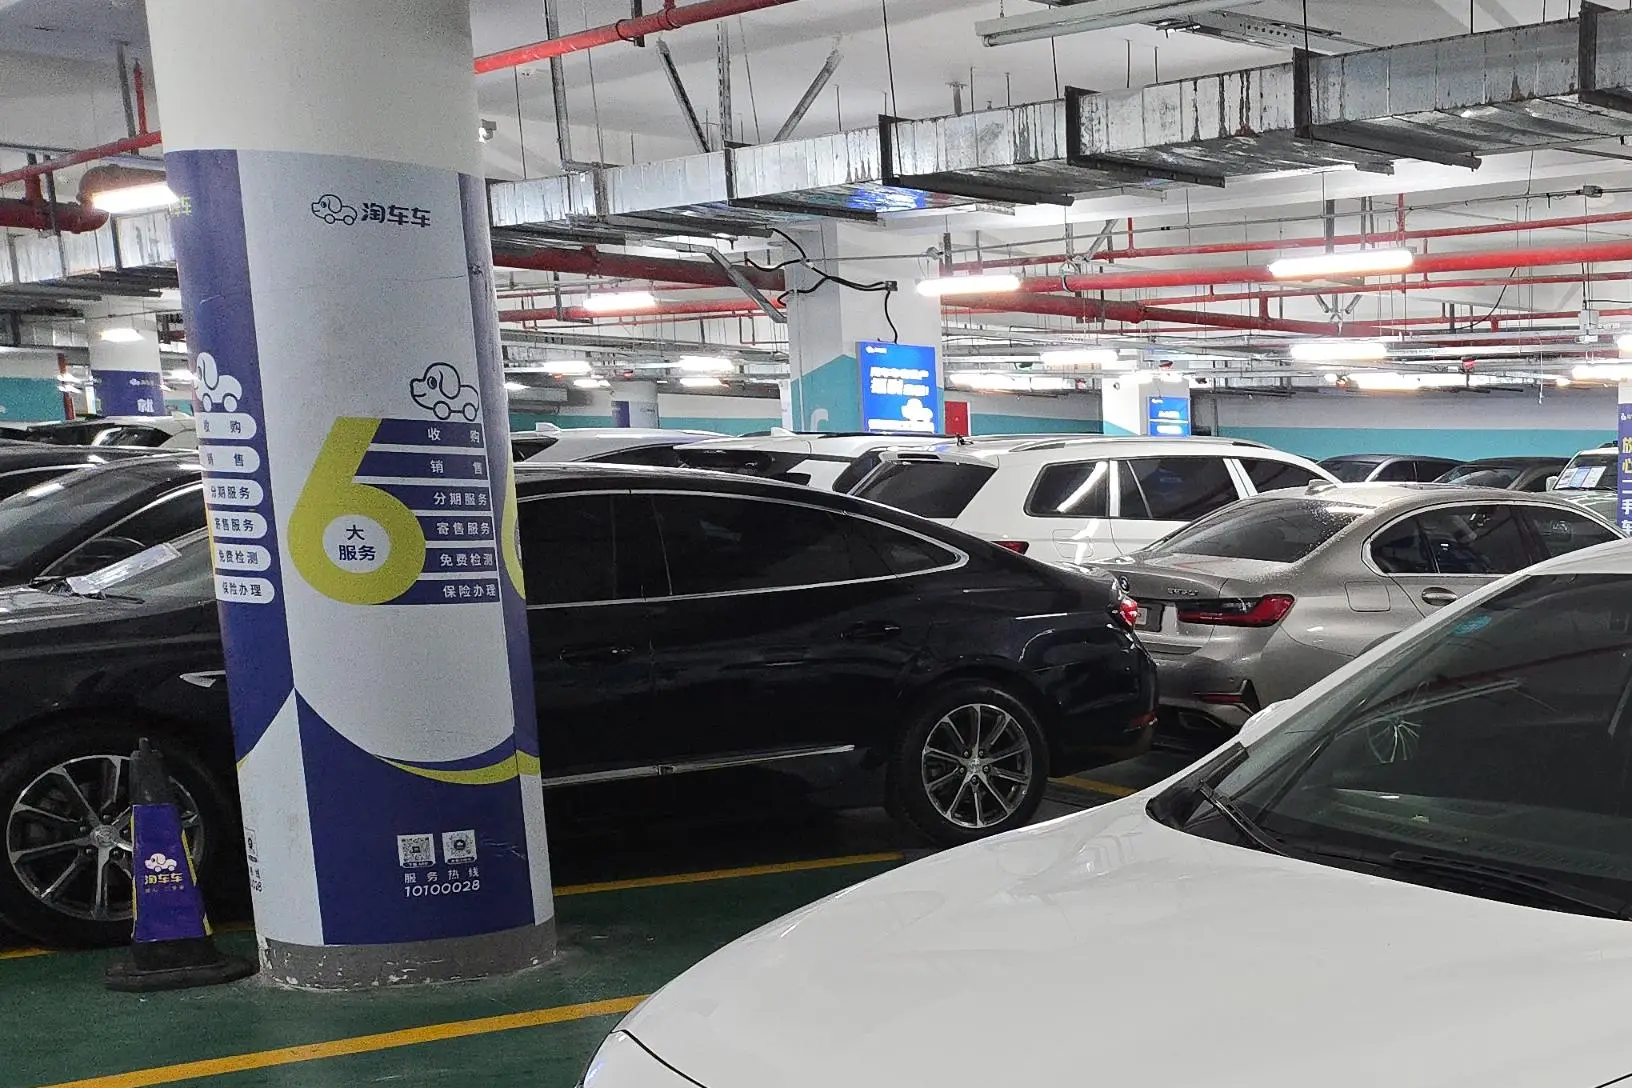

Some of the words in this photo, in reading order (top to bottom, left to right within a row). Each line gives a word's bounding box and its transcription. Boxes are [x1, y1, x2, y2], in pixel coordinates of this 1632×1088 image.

[361, 202, 431, 228] 淘车车
[427, 427, 481, 443] 收购
[430, 460, 483, 475] 销售
[433, 491, 489, 506] 分期服务
[345, 524, 366, 541] 大
[436, 521, 491, 536] 寄售服务
[338, 544, 377, 561] 服务
[439, 553, 494, 567] 免费检测
[442, 584, 497, 599] 保险办理
[404, 866, 480, 884] 服务热线
[404, 879, 480, 897] 10100028
